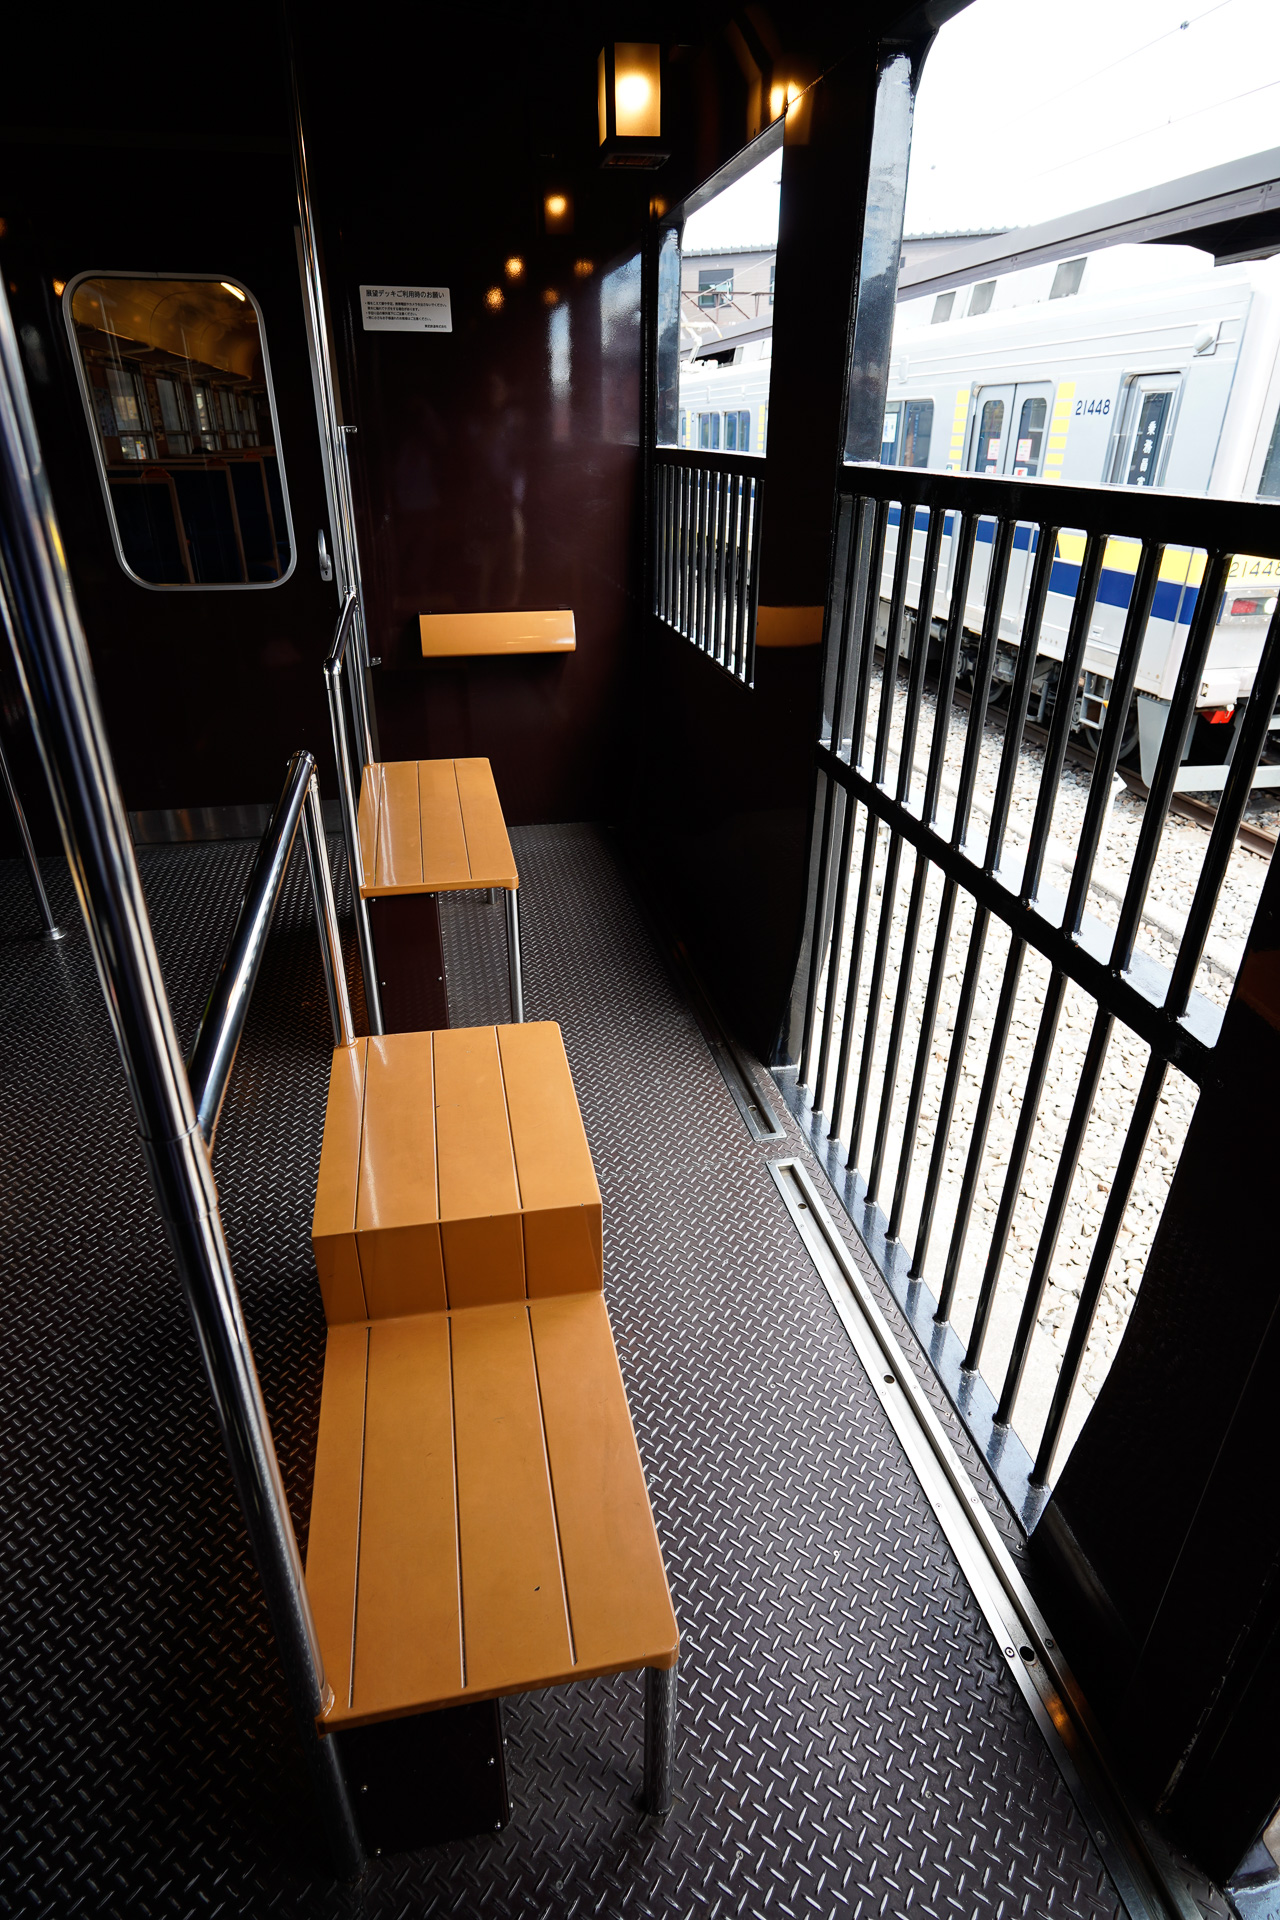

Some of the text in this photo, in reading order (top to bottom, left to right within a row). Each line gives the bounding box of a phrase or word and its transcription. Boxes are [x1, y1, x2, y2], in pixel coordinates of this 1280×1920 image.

[366, 289, 445, 299] 展望デッキご利用時のお願い
[1075, 398, 1111, 417] 21448
